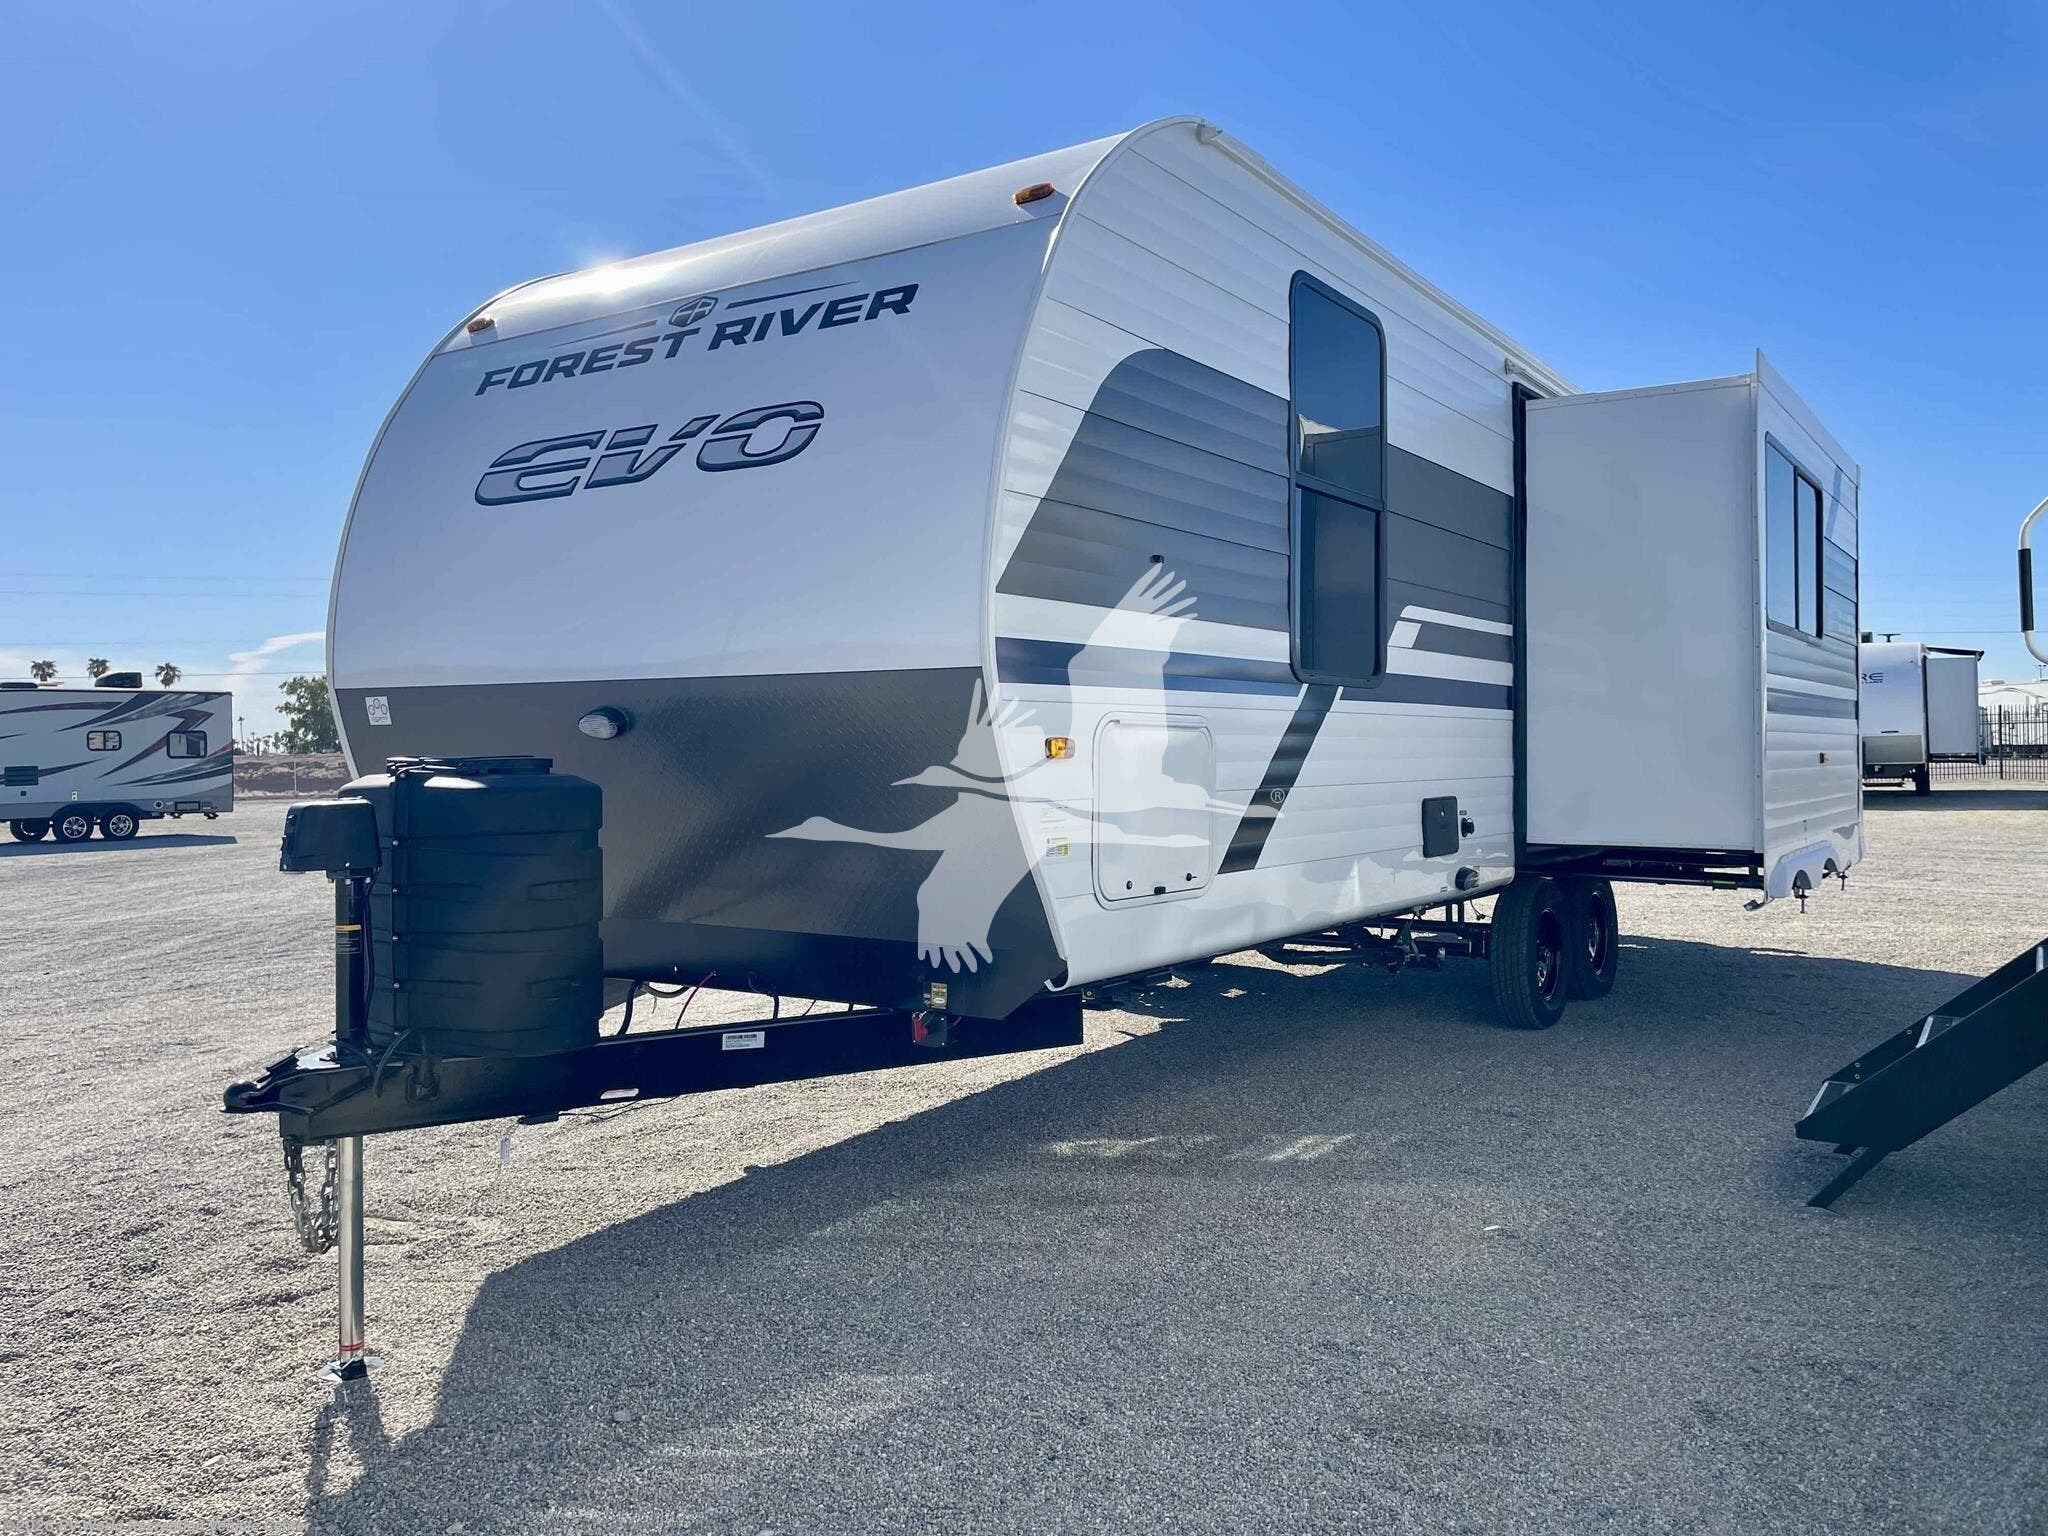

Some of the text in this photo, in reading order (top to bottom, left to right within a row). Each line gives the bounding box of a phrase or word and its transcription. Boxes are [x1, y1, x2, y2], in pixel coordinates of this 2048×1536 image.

[475, 283, 919, 396] FOREST RIVER
[475, 400, 825, 506] EVO
